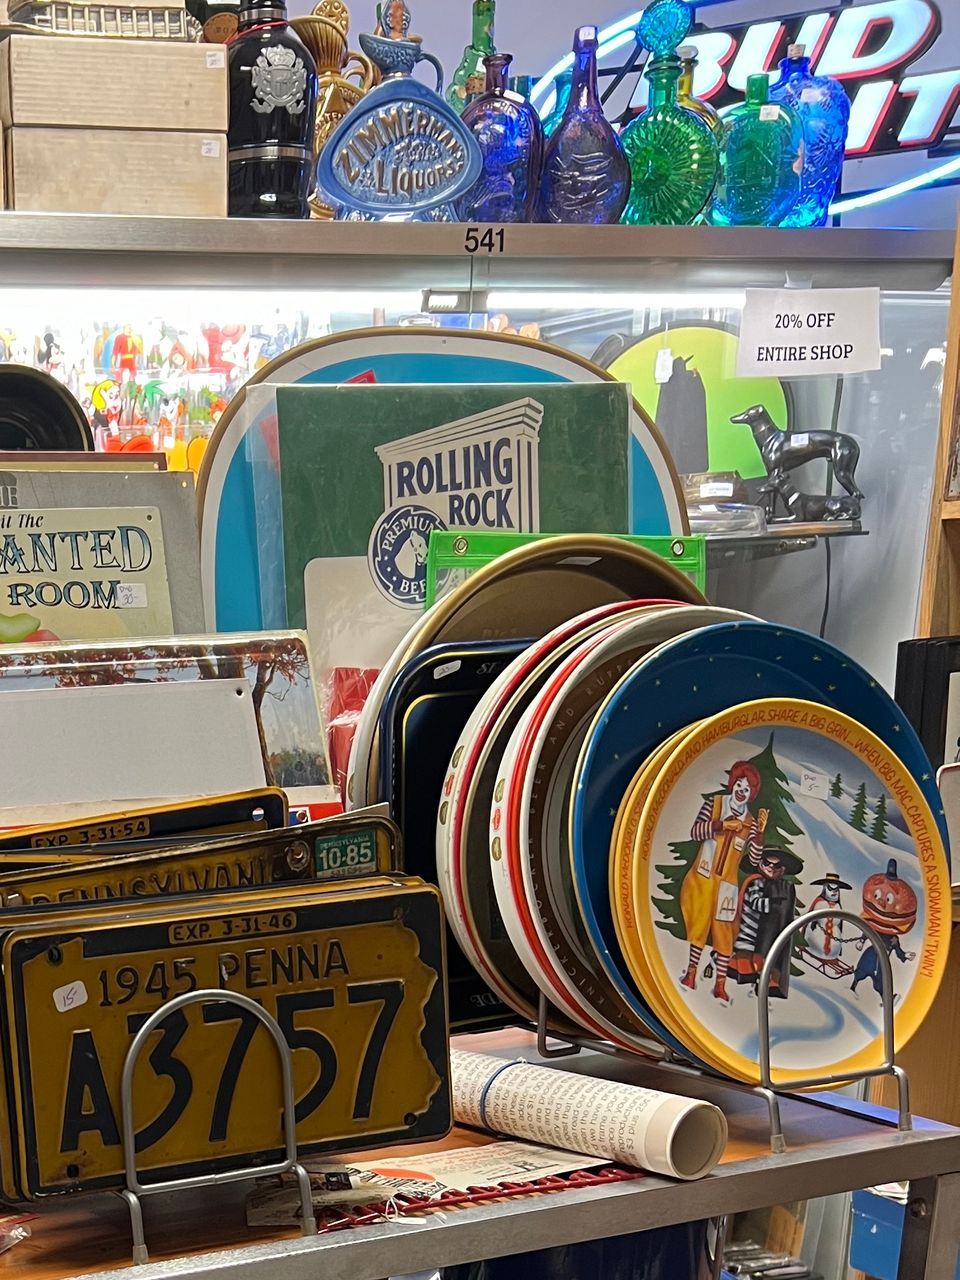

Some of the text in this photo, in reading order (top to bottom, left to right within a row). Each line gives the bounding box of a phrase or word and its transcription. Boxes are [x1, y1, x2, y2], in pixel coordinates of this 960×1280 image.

[630, 0, 937, 111] BUD
[464, 228, 506, 253] 541
[775, 312, 835, 330] 20% OFF
[756, 343, 854, 362] ENTIRE SHOP
[397, 438, 513, 498] ROLLING
[18, 513, 45, 528] The
[449, 488, 514, 528] ROCK
[9, 580, 119, 610] ROOM
[80, 821, 146, 842] 3-31-54
[702, 708, 942, 936] HAMBURGLAR SHARE BIG WHEN BIG CAPTURES SNOWMAN
[173, 913, 293, 941] EXP. 3-31-46
[99, 940, 349, 1008] 1945 PENNA
